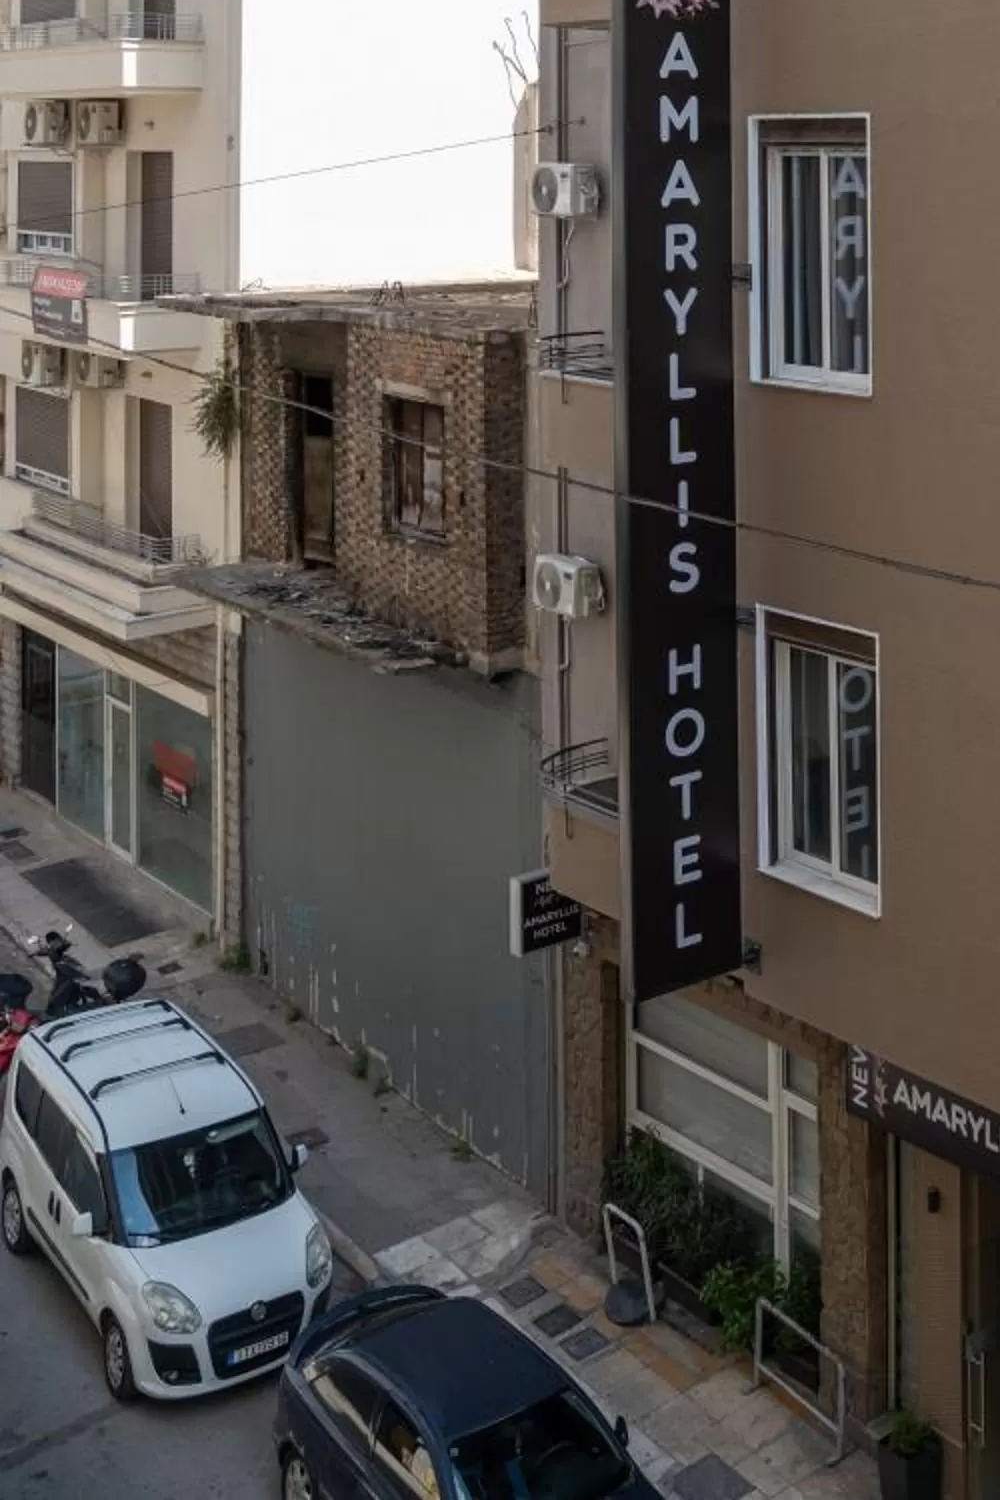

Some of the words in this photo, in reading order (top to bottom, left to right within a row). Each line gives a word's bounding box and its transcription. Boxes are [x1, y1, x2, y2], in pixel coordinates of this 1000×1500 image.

[658, 31, 701, 594] AMARYLLIS
[664, 643, 705, 949] HOTEL
[523, 904, 580, 929] AMARYLLIS
[533, 921, 567, 940] HOTEL
